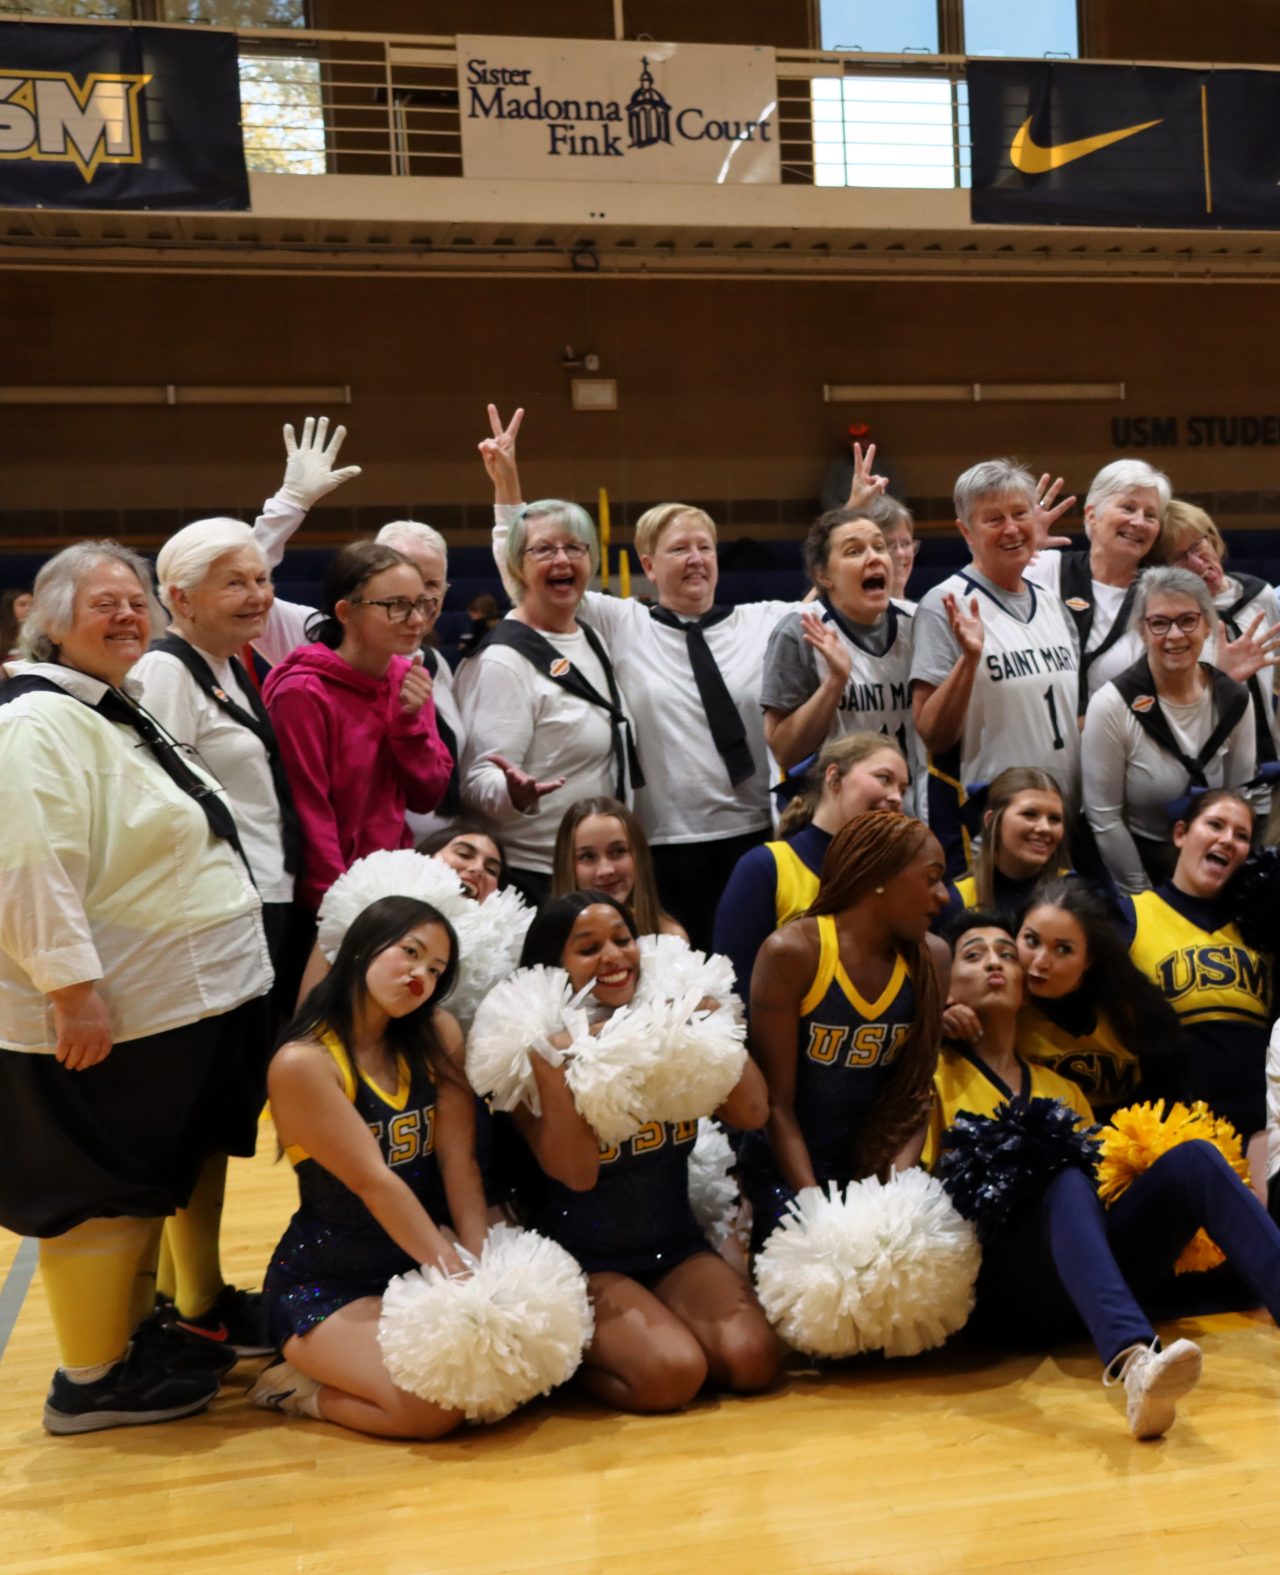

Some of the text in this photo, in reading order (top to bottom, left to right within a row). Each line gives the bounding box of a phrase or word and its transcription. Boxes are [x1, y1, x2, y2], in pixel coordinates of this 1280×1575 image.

[466, 60, 531, 86] Sister
[468, 87, 623, 122] Madonna
[0, 69, 153, 184] SM
[547, 124, 624, 156] Fink
[676, 108, 771, 142] Court
[1111, 417, 1177, 448] USM
[986, 649, 1041, 682] SAINT
[1044, 684, 1065, 751] 1
[1156, 944, 1274, 1014] USM
